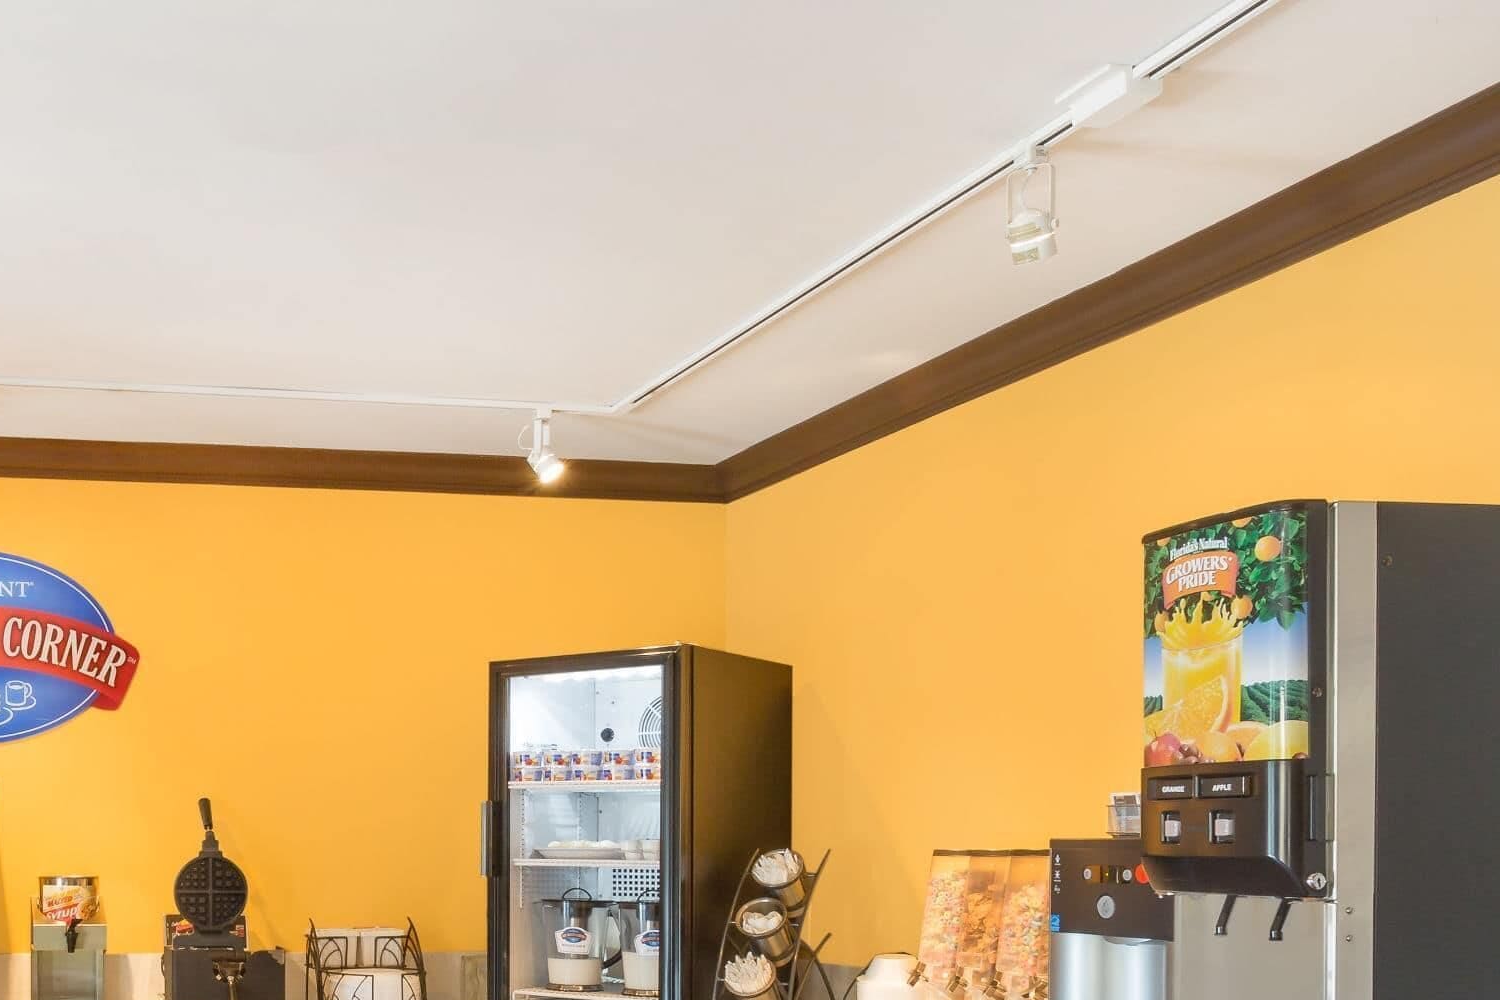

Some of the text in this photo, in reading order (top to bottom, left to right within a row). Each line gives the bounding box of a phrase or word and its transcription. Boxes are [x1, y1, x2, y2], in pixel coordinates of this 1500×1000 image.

[1199, 536, 1228, 551] Natural
[1178, 570, 1216, 592] PRIDE
[2, 617, 126, 688] CORNER
[1211, 783, 1232, 792] APPLE
